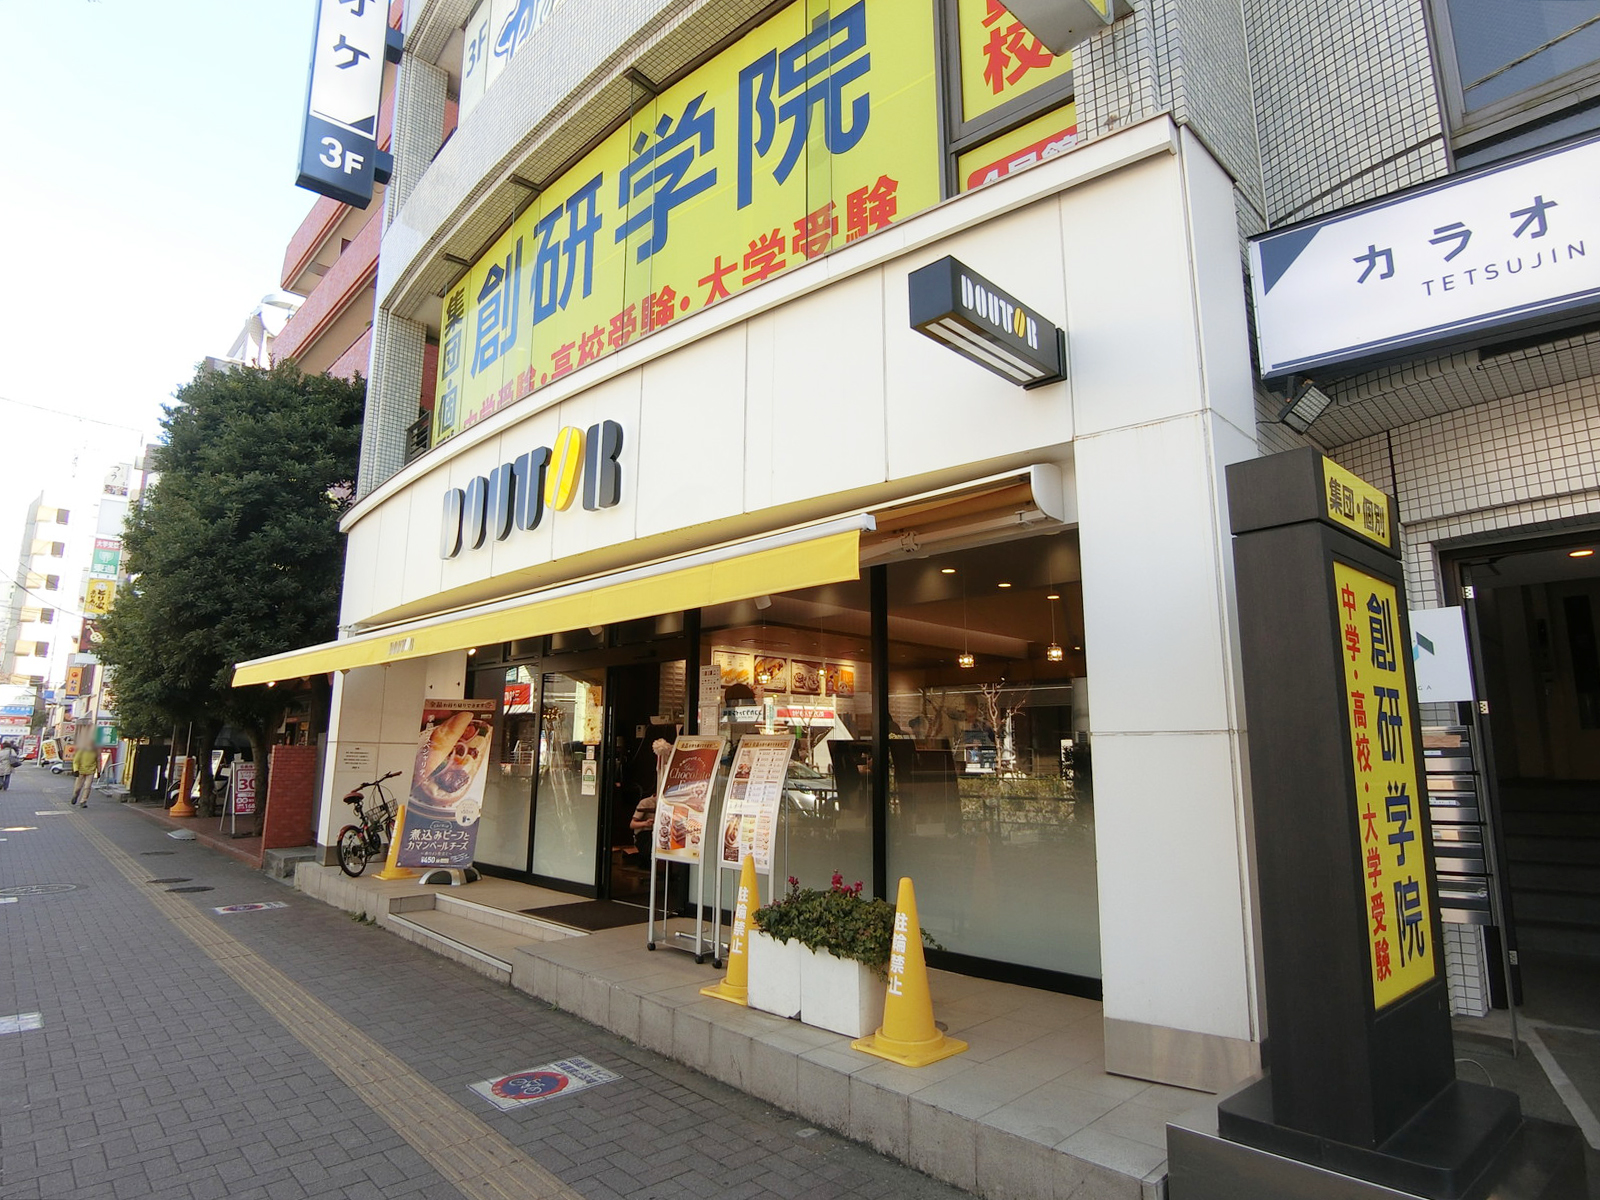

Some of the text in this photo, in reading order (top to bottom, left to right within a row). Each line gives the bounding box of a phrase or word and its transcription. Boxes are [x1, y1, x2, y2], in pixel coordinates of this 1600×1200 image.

[466, 19, 488, 78] 3F
[319, 136, 364, 175] 3F
[470, 0, 871, 379] 創研学院
[1353, 195, 1558, 284] カラオ
[1421, 241, 1586, 296] TETSUJIN
[961, 274, 1038, 350] DOUTOR
[436, 287, 465, 446] 集団・個
[439, 419, 624, 560] DOUTOR
[1329, 476, 1385, 539] 集団・個別
[1341, 583, 1392, 982] 中学・高校・大学受験
[1366, 592, 1424, 968] 創研学院
